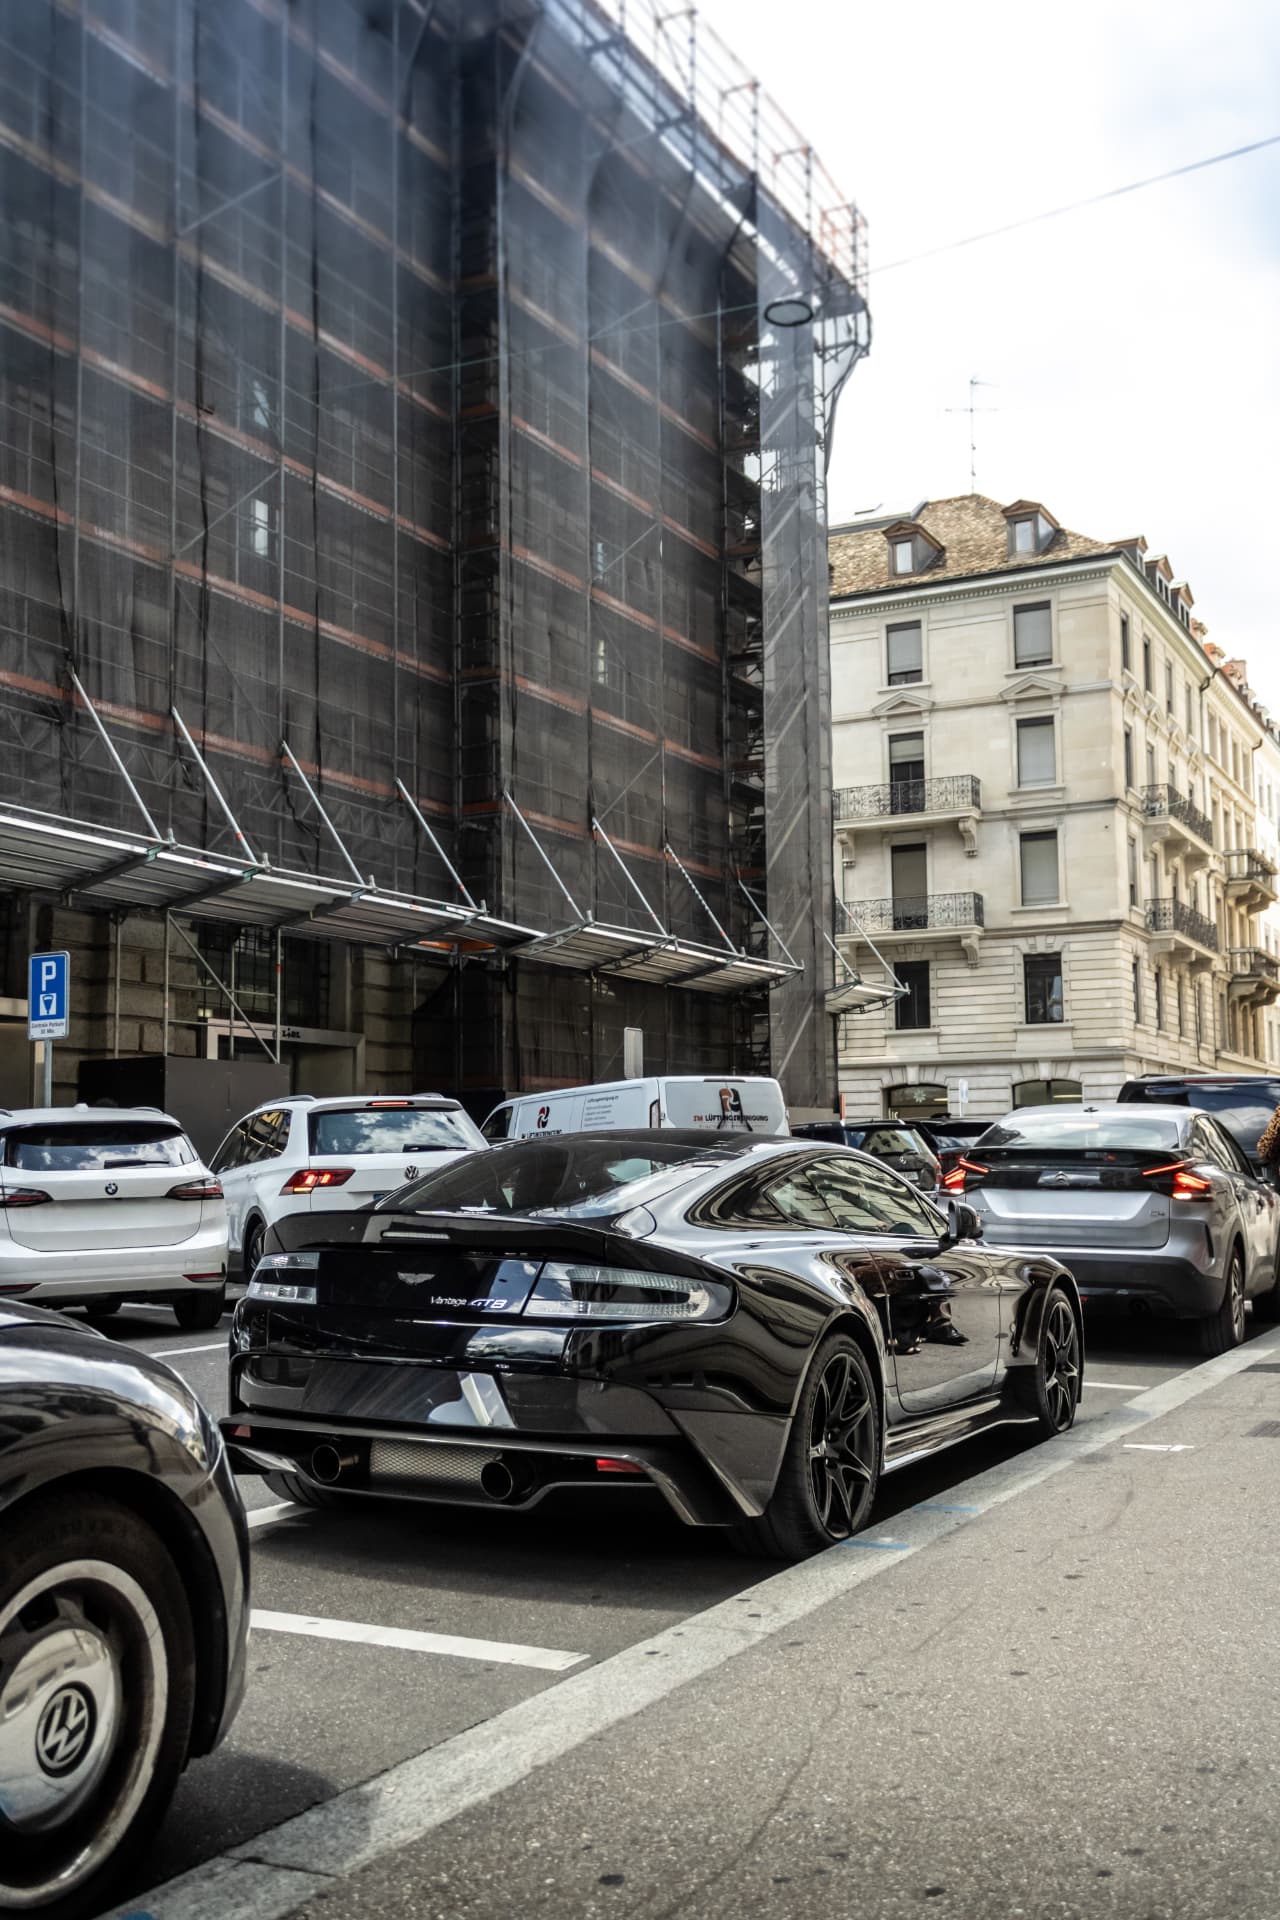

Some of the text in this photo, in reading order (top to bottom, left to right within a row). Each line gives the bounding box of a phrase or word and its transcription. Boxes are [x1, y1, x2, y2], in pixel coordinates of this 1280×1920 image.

[42, 961, 57, 992] P
[705, 1113, 768, 1122] LÜFTUNGSRINIGUNG
[430, 1295, 467, 1307] Vantage
[38, 1688, 89, 1769] VW
